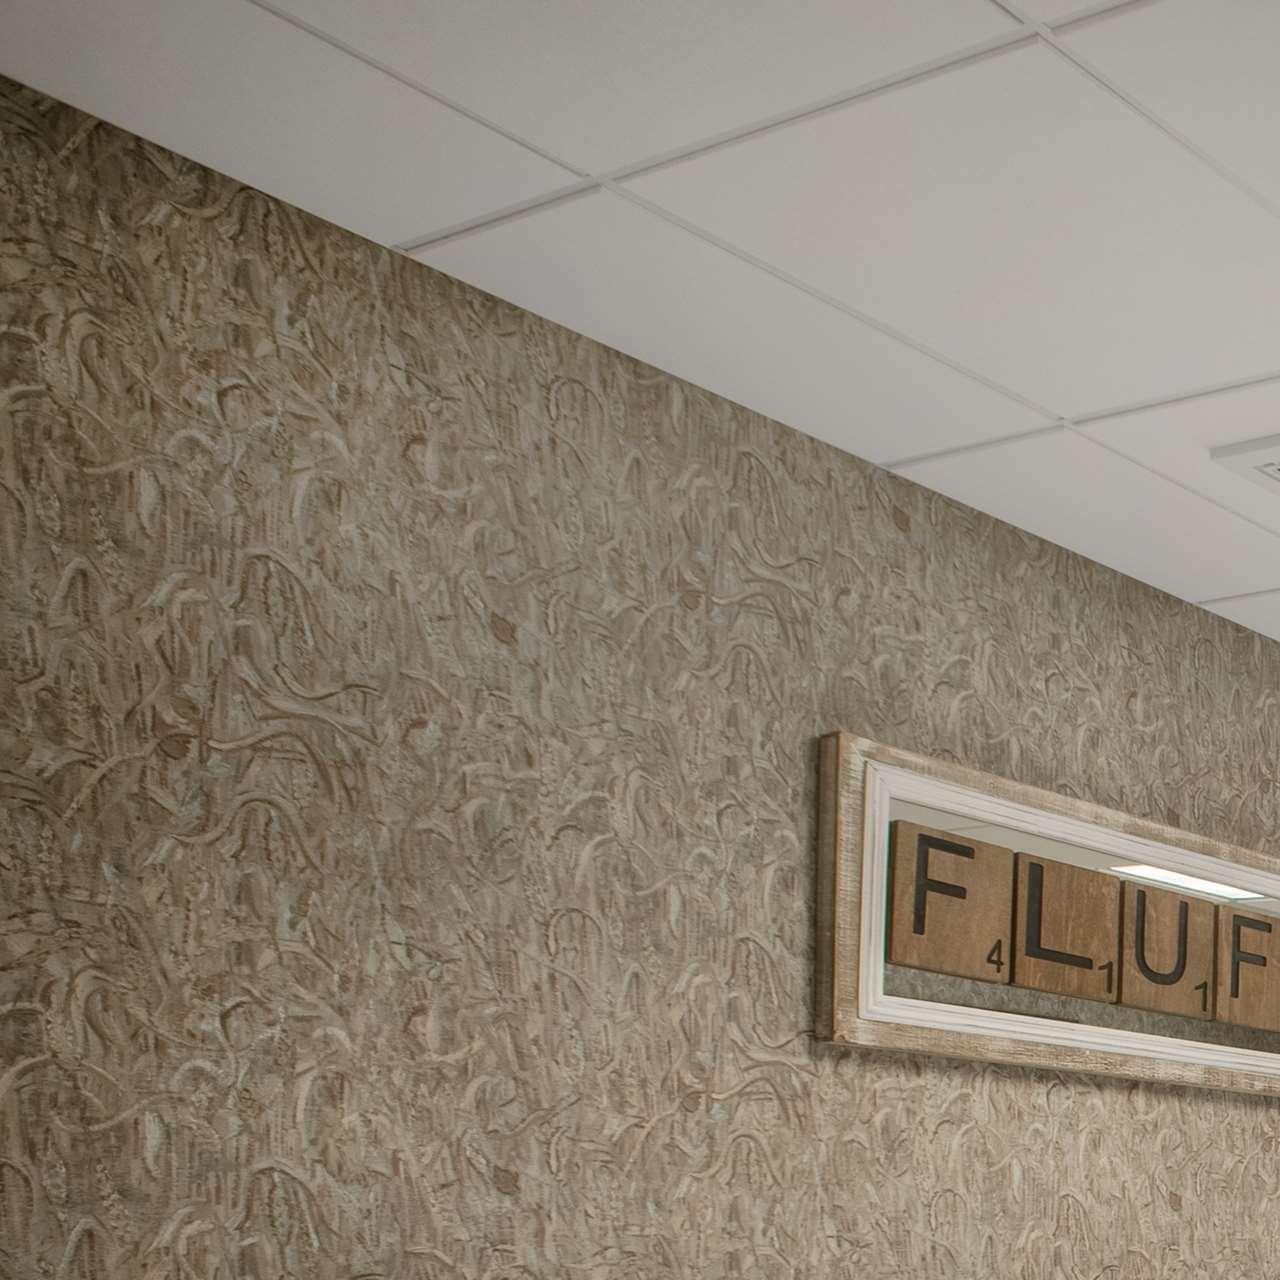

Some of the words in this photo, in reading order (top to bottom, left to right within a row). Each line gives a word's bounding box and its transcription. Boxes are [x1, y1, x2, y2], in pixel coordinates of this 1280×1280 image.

[986, 939, 1004, 974] 4
[1097, 961, 1114, 993] 1
[1194, 981, 1208, 1012] 1
